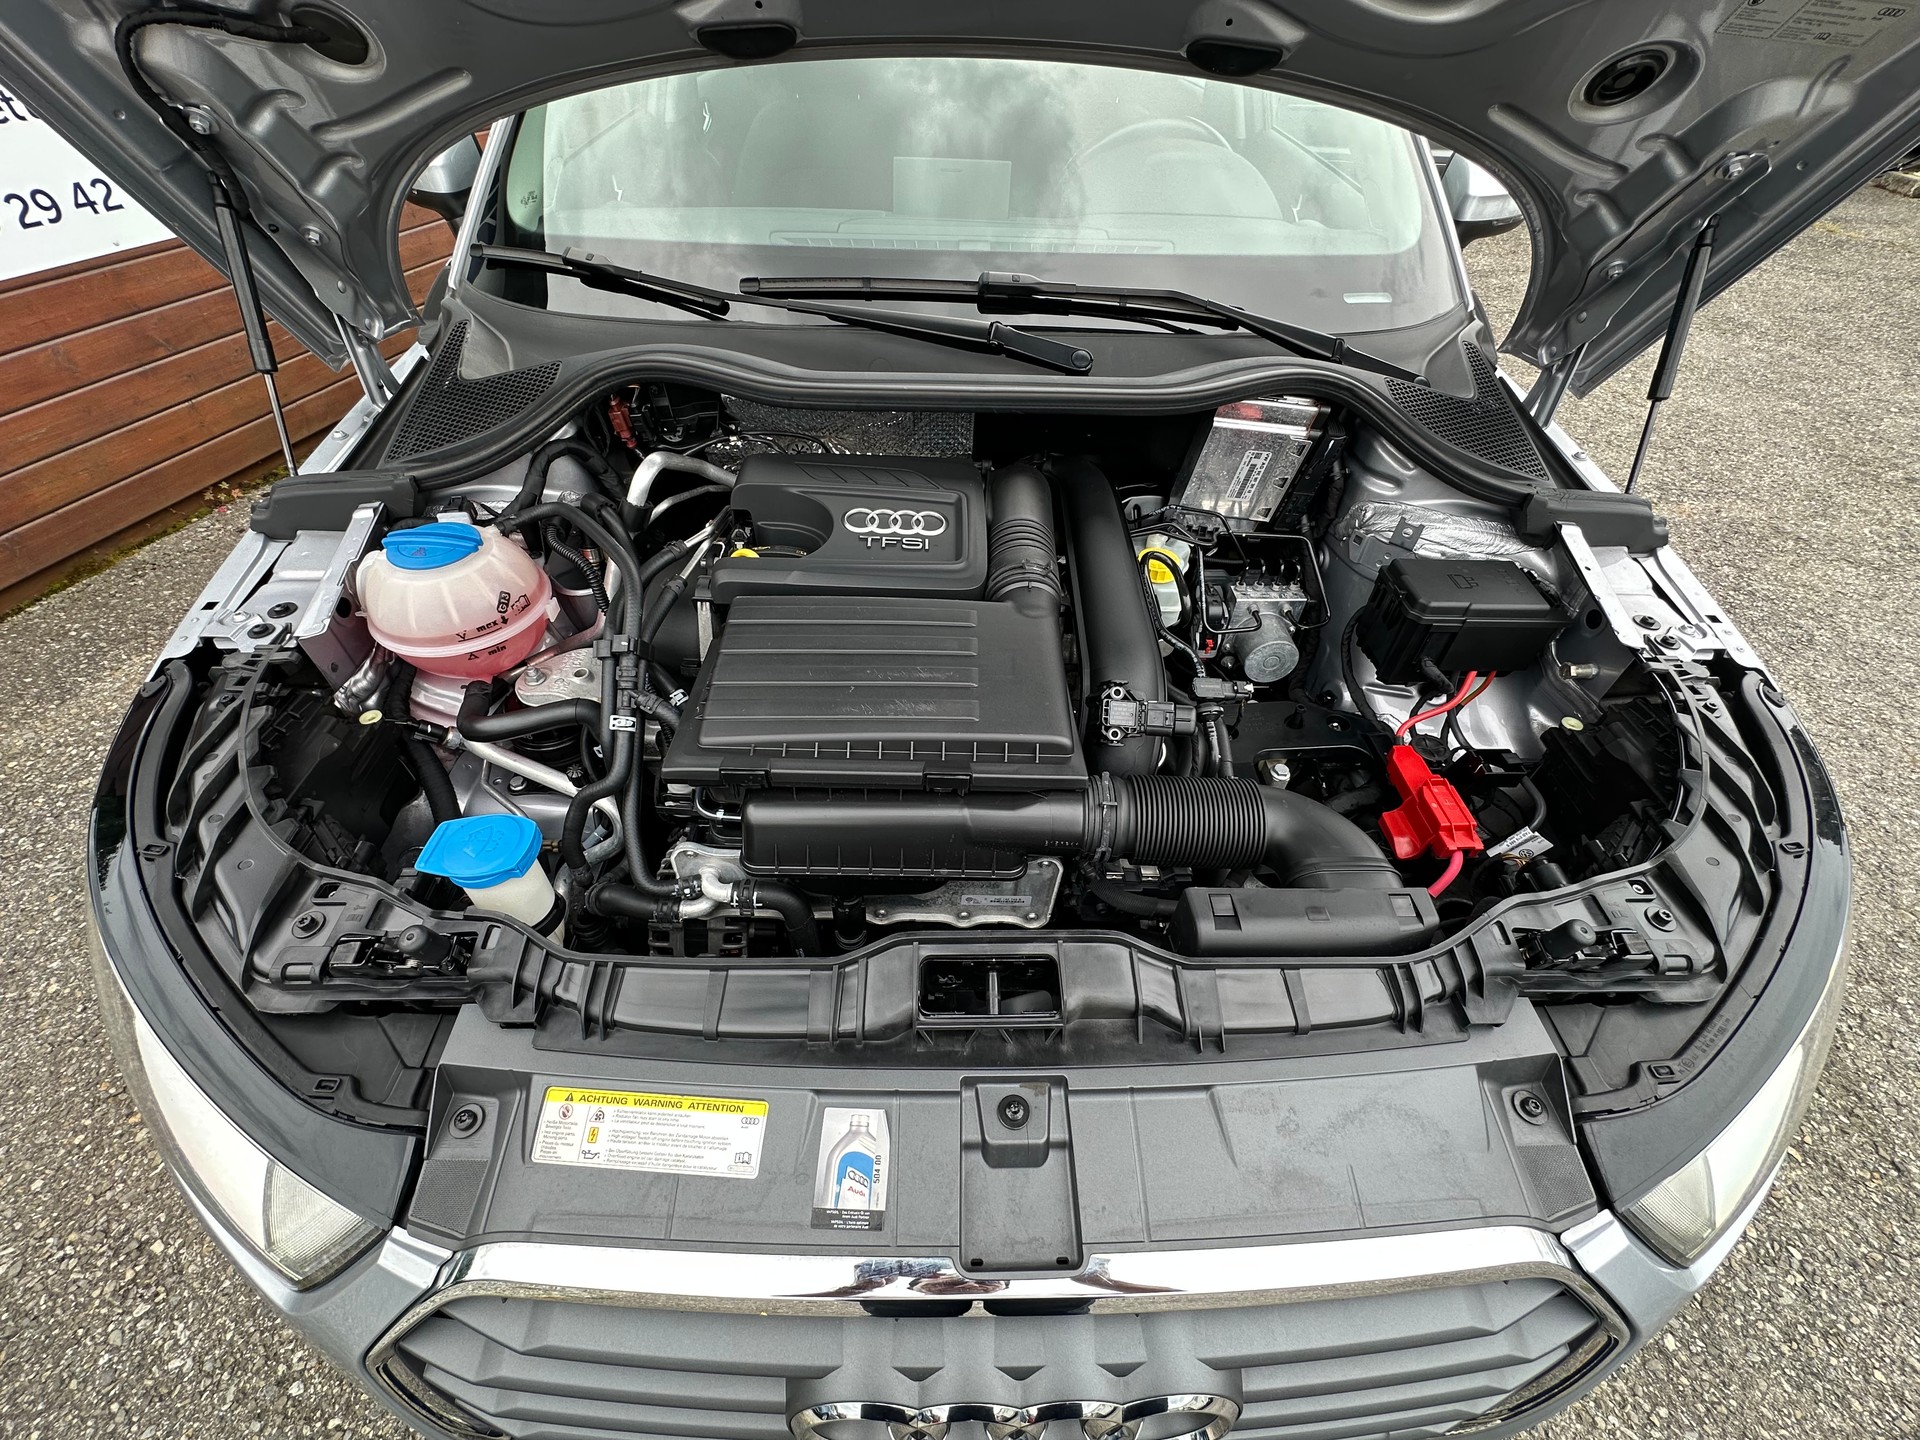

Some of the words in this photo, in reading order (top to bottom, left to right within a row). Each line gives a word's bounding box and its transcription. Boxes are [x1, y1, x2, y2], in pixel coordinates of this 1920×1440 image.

[3, 188, 62, 230] 29
[73, 178, 125, 215] 42
[859, 535, 929, 550] TFSI
[499, 593, 510, 612] G13
[488, 645, 507, 656] min
[578, 1094, 628, 1105] ACHTUNG
[632, 1097, 683, 1109] WARNING
[688, 1101, 744, 1113] ATTENTION
[874, 1154, 882, 1166] 00
[872, 1168, 881, 1184] 504
[847, 1186, 866, 1198] Audi
